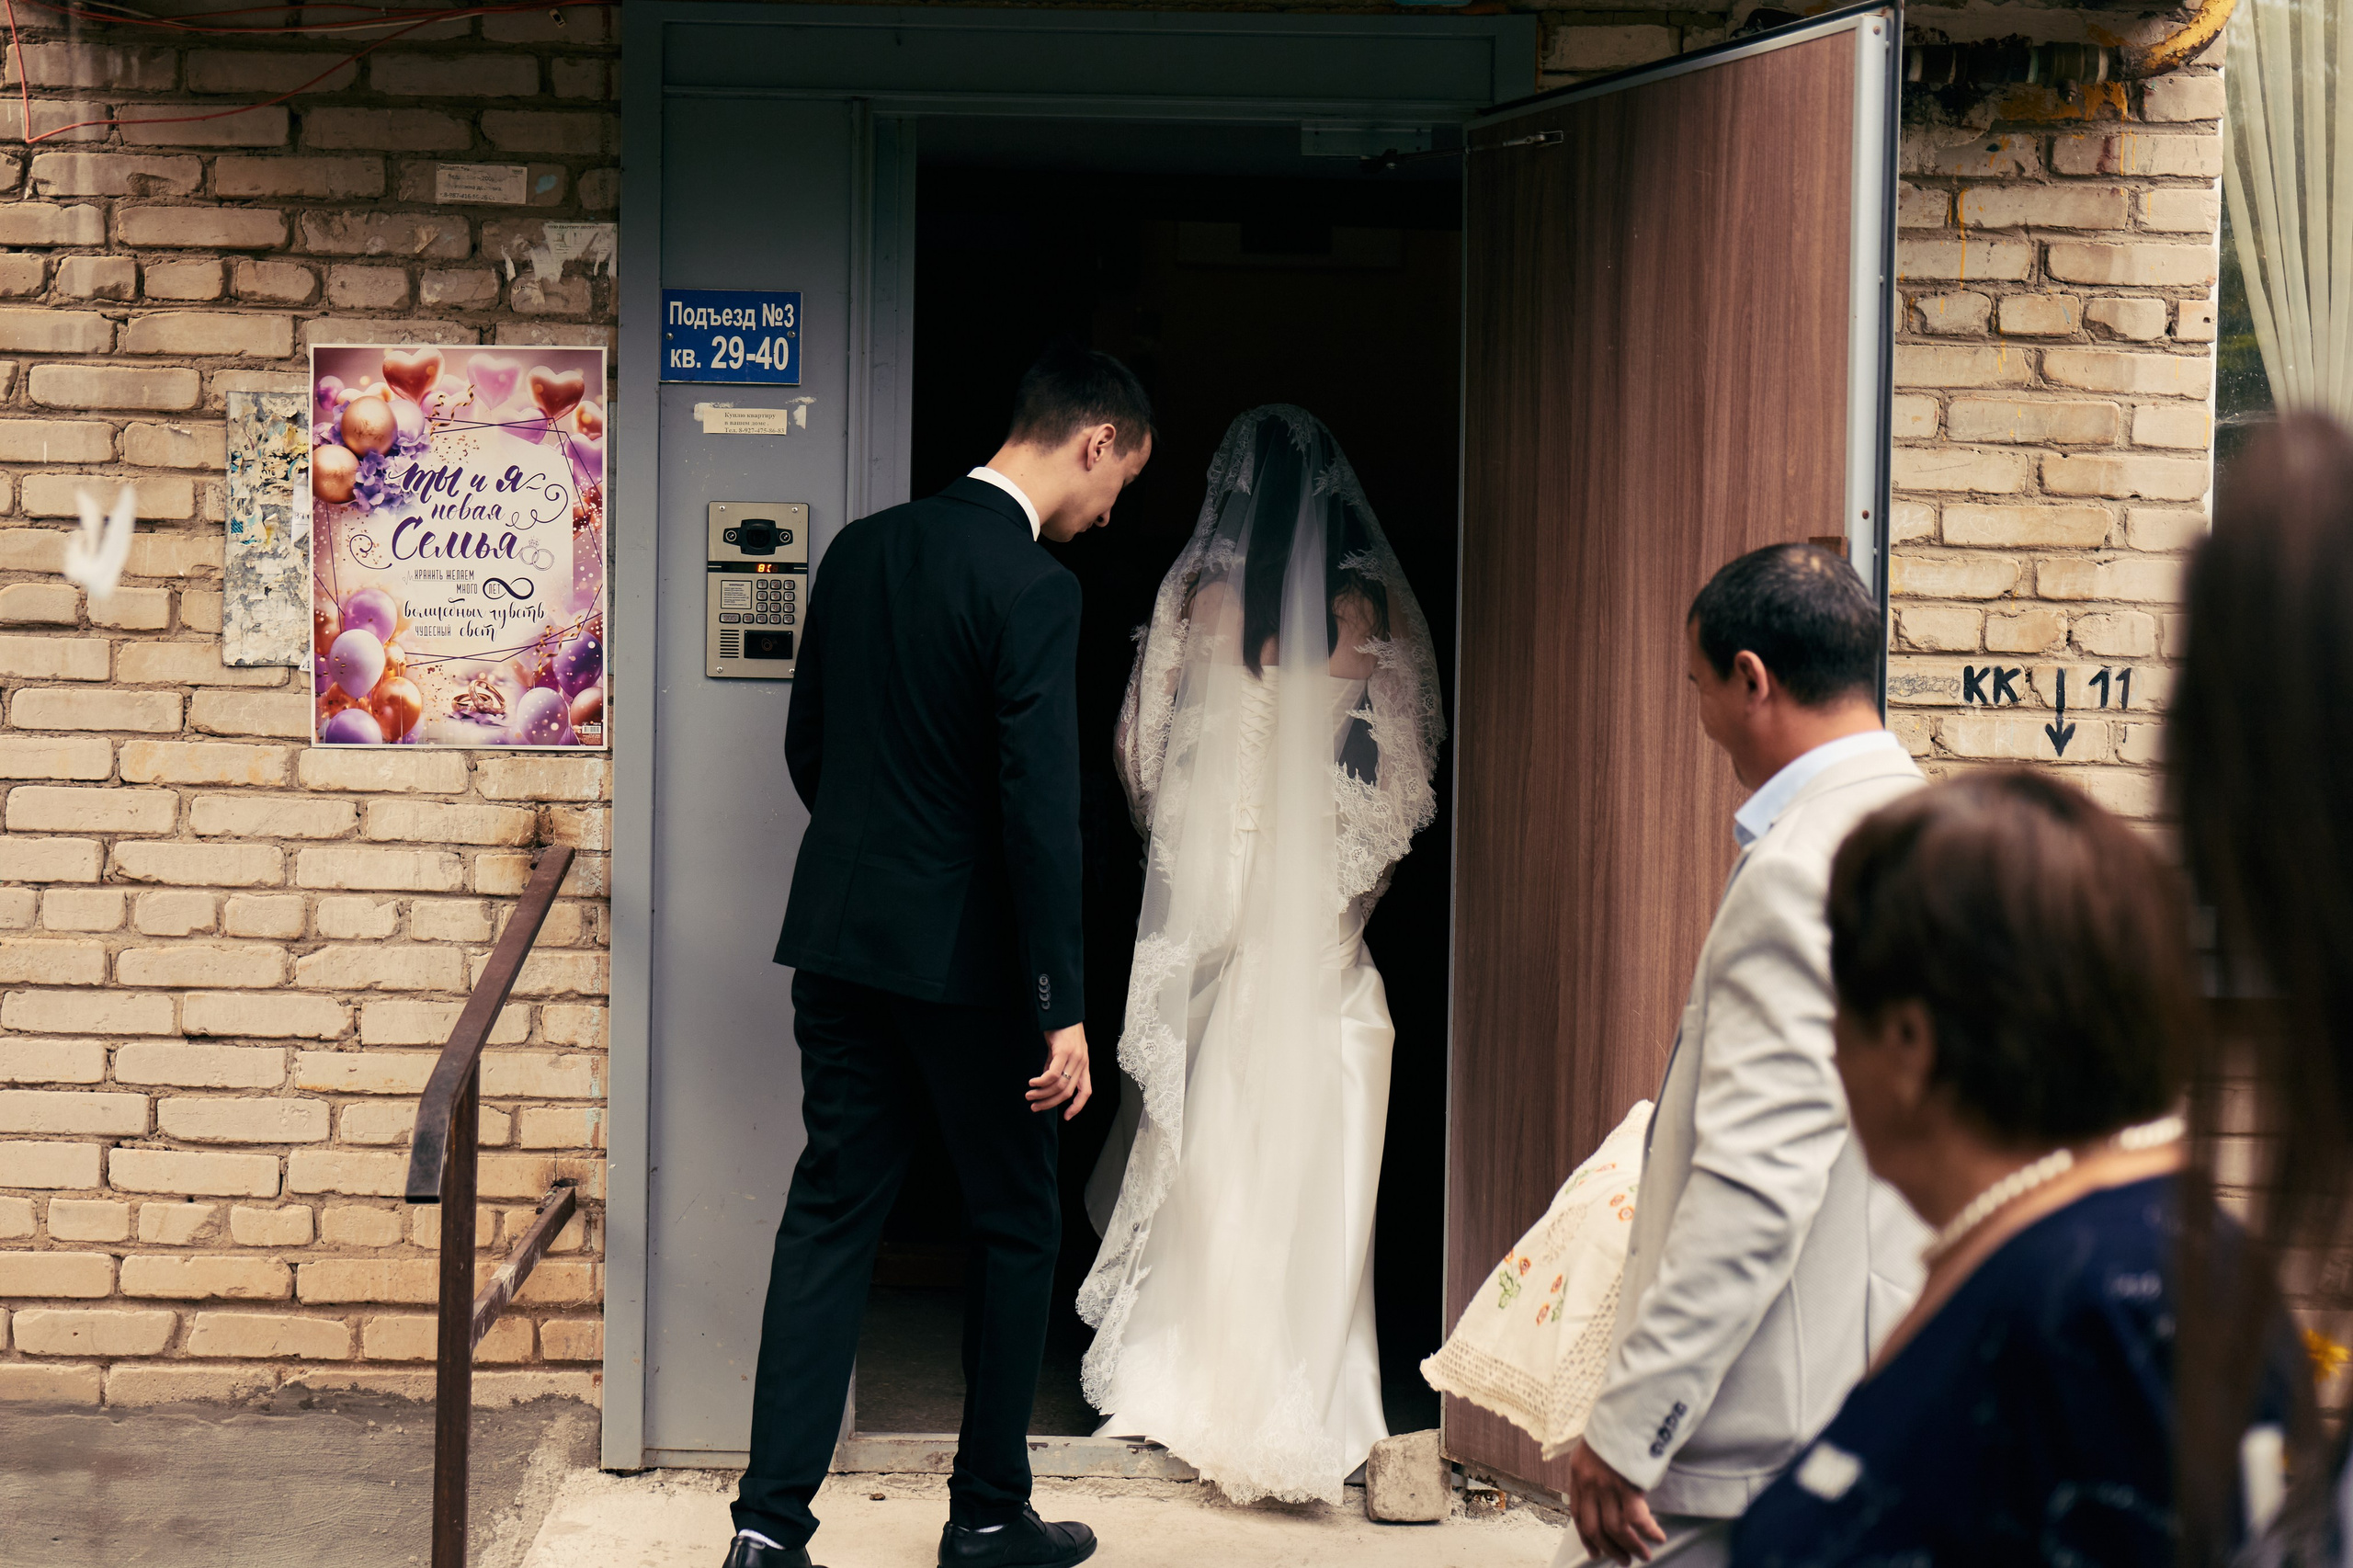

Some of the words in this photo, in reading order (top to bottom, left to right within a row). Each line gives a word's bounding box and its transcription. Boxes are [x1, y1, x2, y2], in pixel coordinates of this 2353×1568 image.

[669, 301, 756, 331] Подъезд
[762, 303, 794, 328] №3
[670, 348, 701, 369] кв.
[710, 335, 789, 370] 29-40
[431, 493, 506, 520] новая
[392, 516, 524, 561] Семья
[415, 569, 443, 580] ХРАНИТЬ
[446, 569, 475, 581] ЖЕЛАЕМ
[456, 584, 478, 595] МНОГО
[488, 584, 501, 595] ЛЕТ
[415, 625, 451, 637] ЧУДЕСНЫЙ
